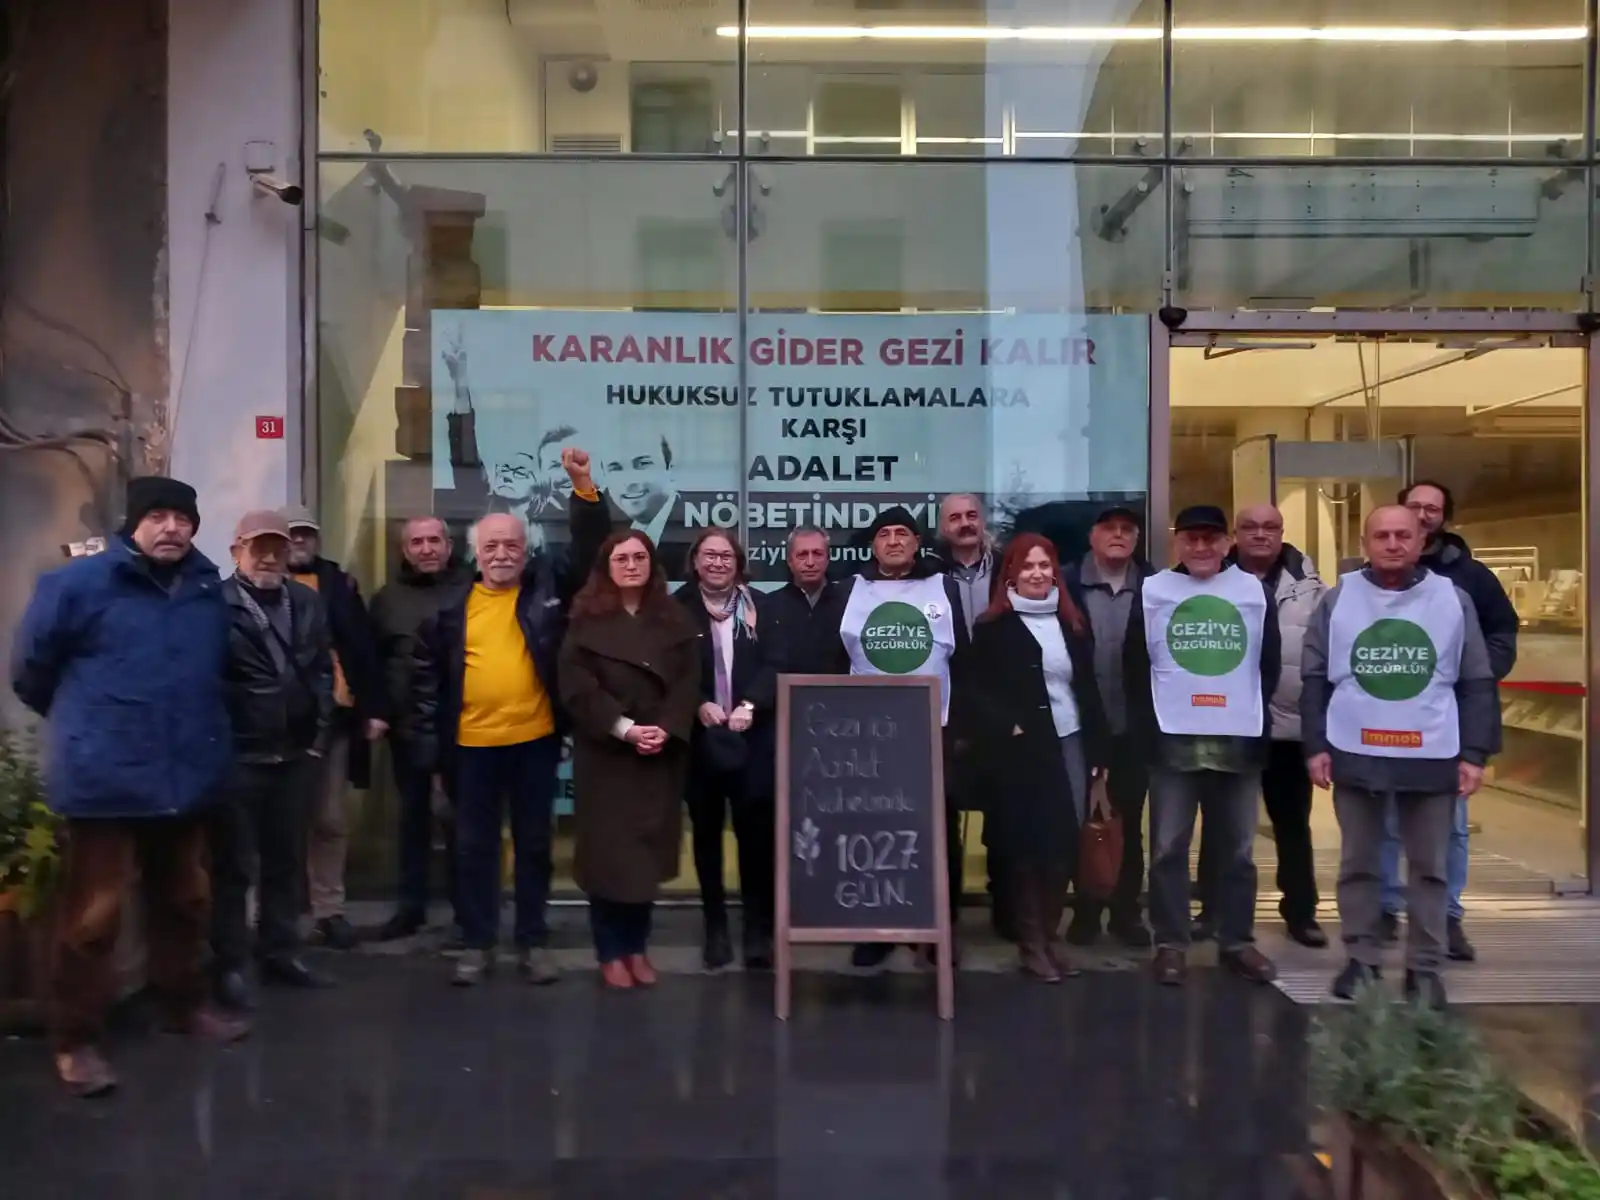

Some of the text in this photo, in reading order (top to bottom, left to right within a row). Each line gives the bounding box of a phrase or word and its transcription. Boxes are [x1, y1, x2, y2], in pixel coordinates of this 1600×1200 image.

[532, 328, 1097, 366] KARANLIK GİDER GEZİ KALIR
[606, 385, 1030, 408] HUKUKSUZ TUTUKLAMALARA
[262, 421, 276, 433] 31
[781, 418, 866, 445] KARŞI
[748, 455, 899, 482] ADALET
[684, 493, 943, 529] NÖBETİNDYİ
[866, 622, 927, 637] GEZİ'YE
[1171, 619, 1240, 637] GEZİ'YE
[1356, 643, 1428, 661] GEZİ'YE
